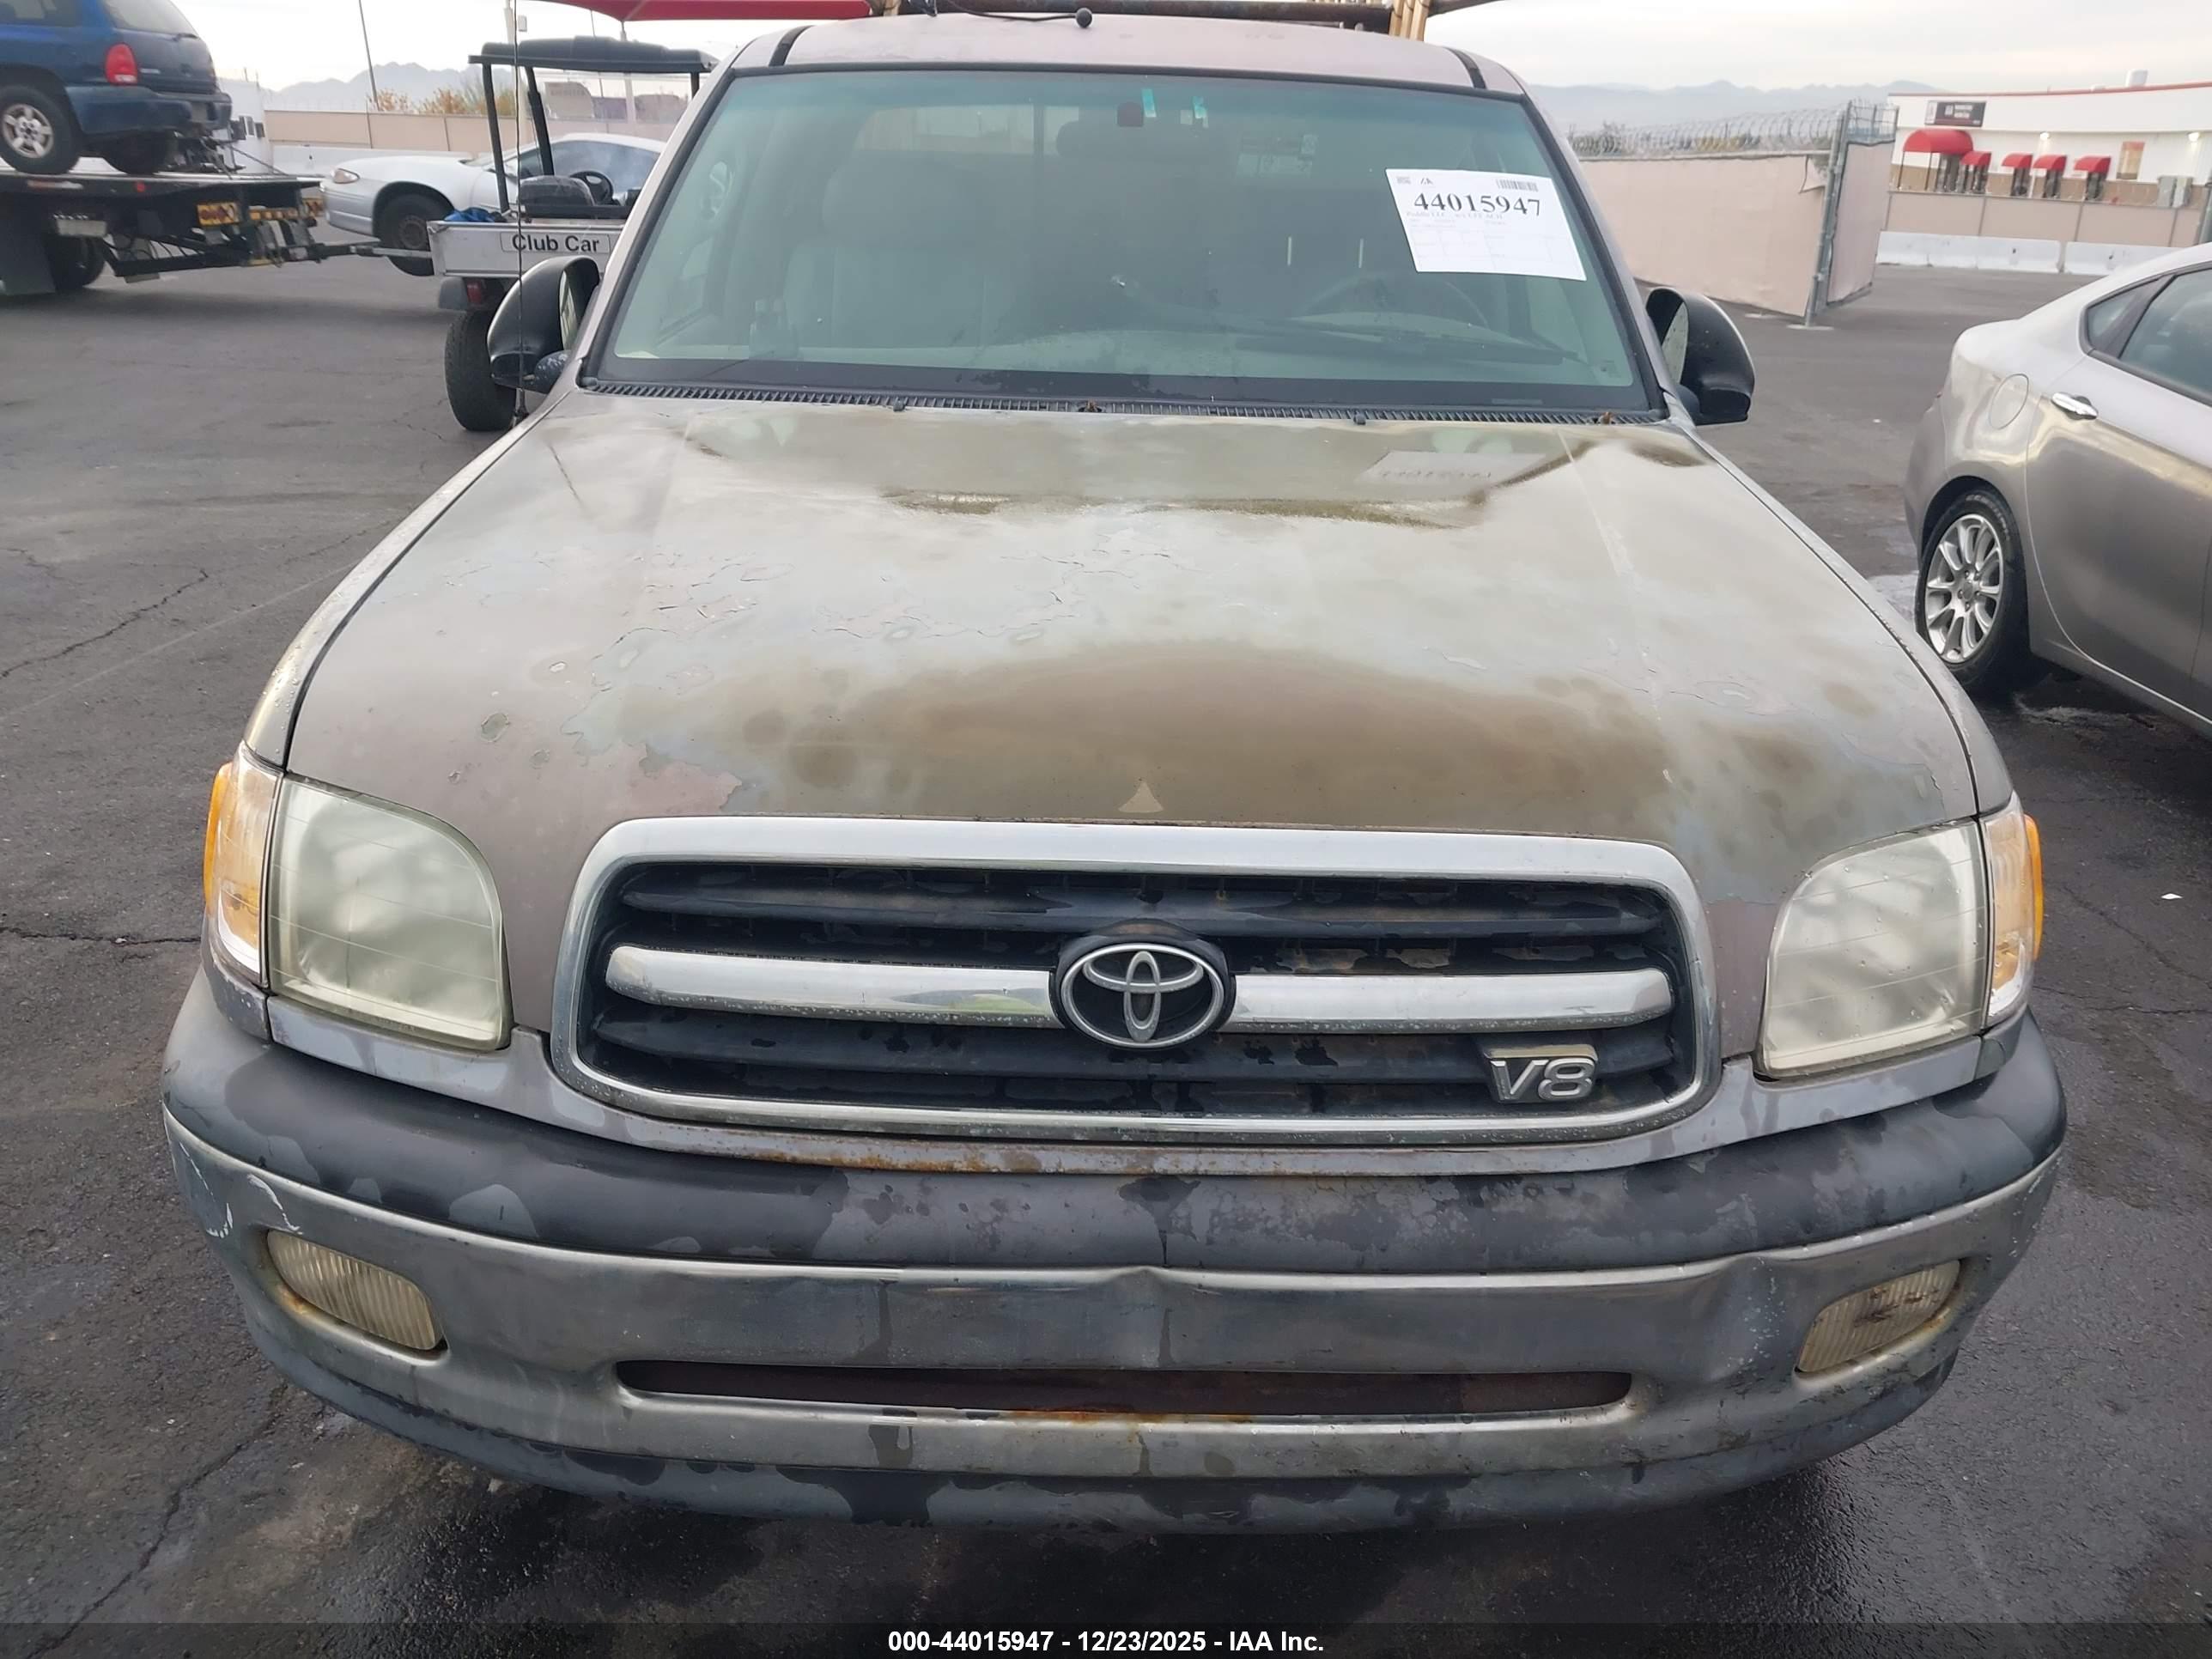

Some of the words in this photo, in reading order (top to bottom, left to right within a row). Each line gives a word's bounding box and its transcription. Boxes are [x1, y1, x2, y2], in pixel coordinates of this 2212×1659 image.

[1413, 191, 1540, 216] 44015947
[512, 234, 559, 252] Club
[564, 234, 600, 252] Car
[1490, 1056, 1595, 1102] V8
